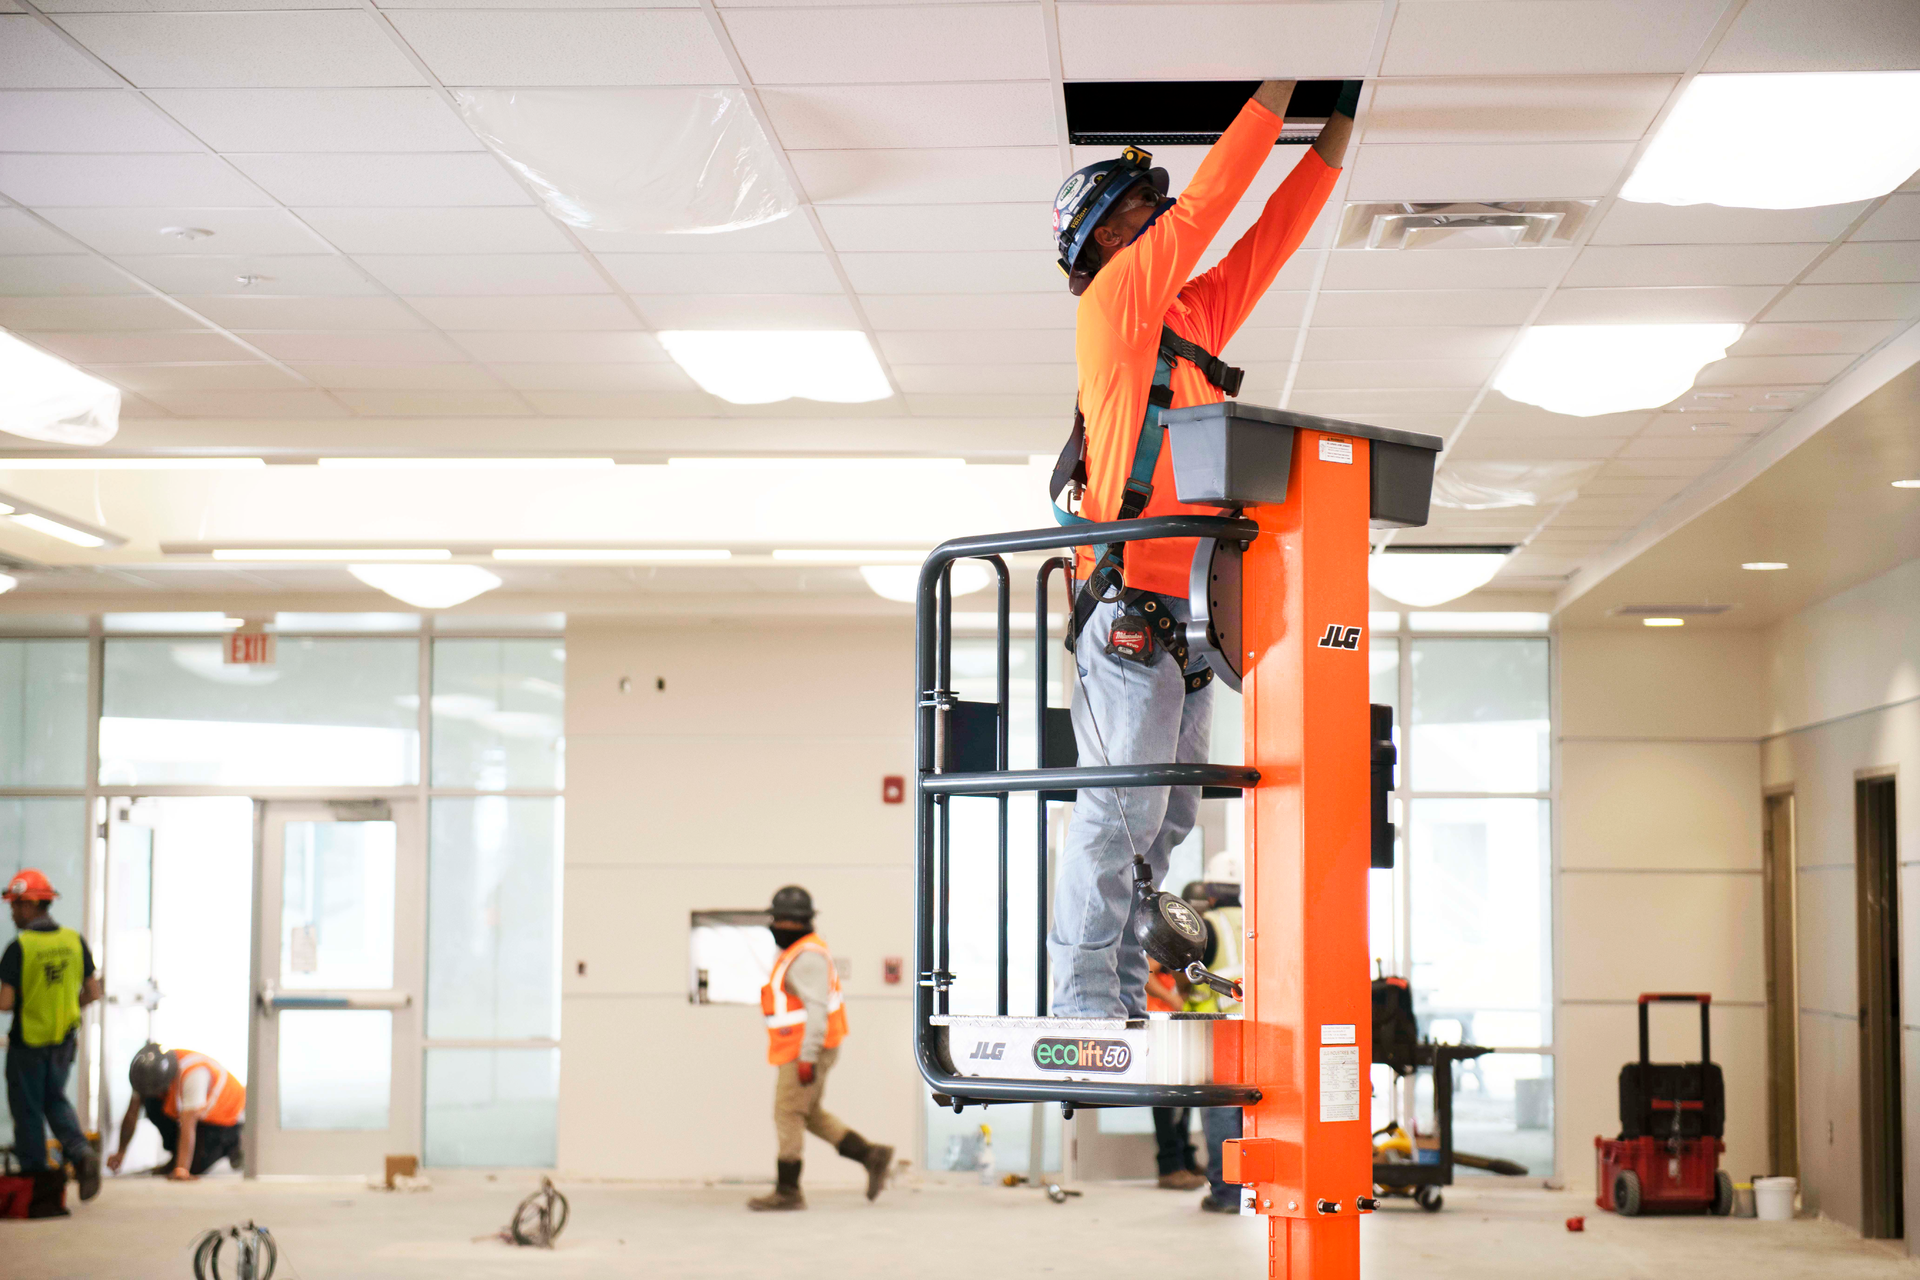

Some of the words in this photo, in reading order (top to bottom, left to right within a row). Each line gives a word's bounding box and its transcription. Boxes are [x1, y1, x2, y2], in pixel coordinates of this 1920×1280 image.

[1116, 631, 1143, 640] Milwaukee
[1318, 624, 1362, 650] JLG
[231, 632, 267, 663] EXIT
[969, 1041, 1006, 1060] JLG
